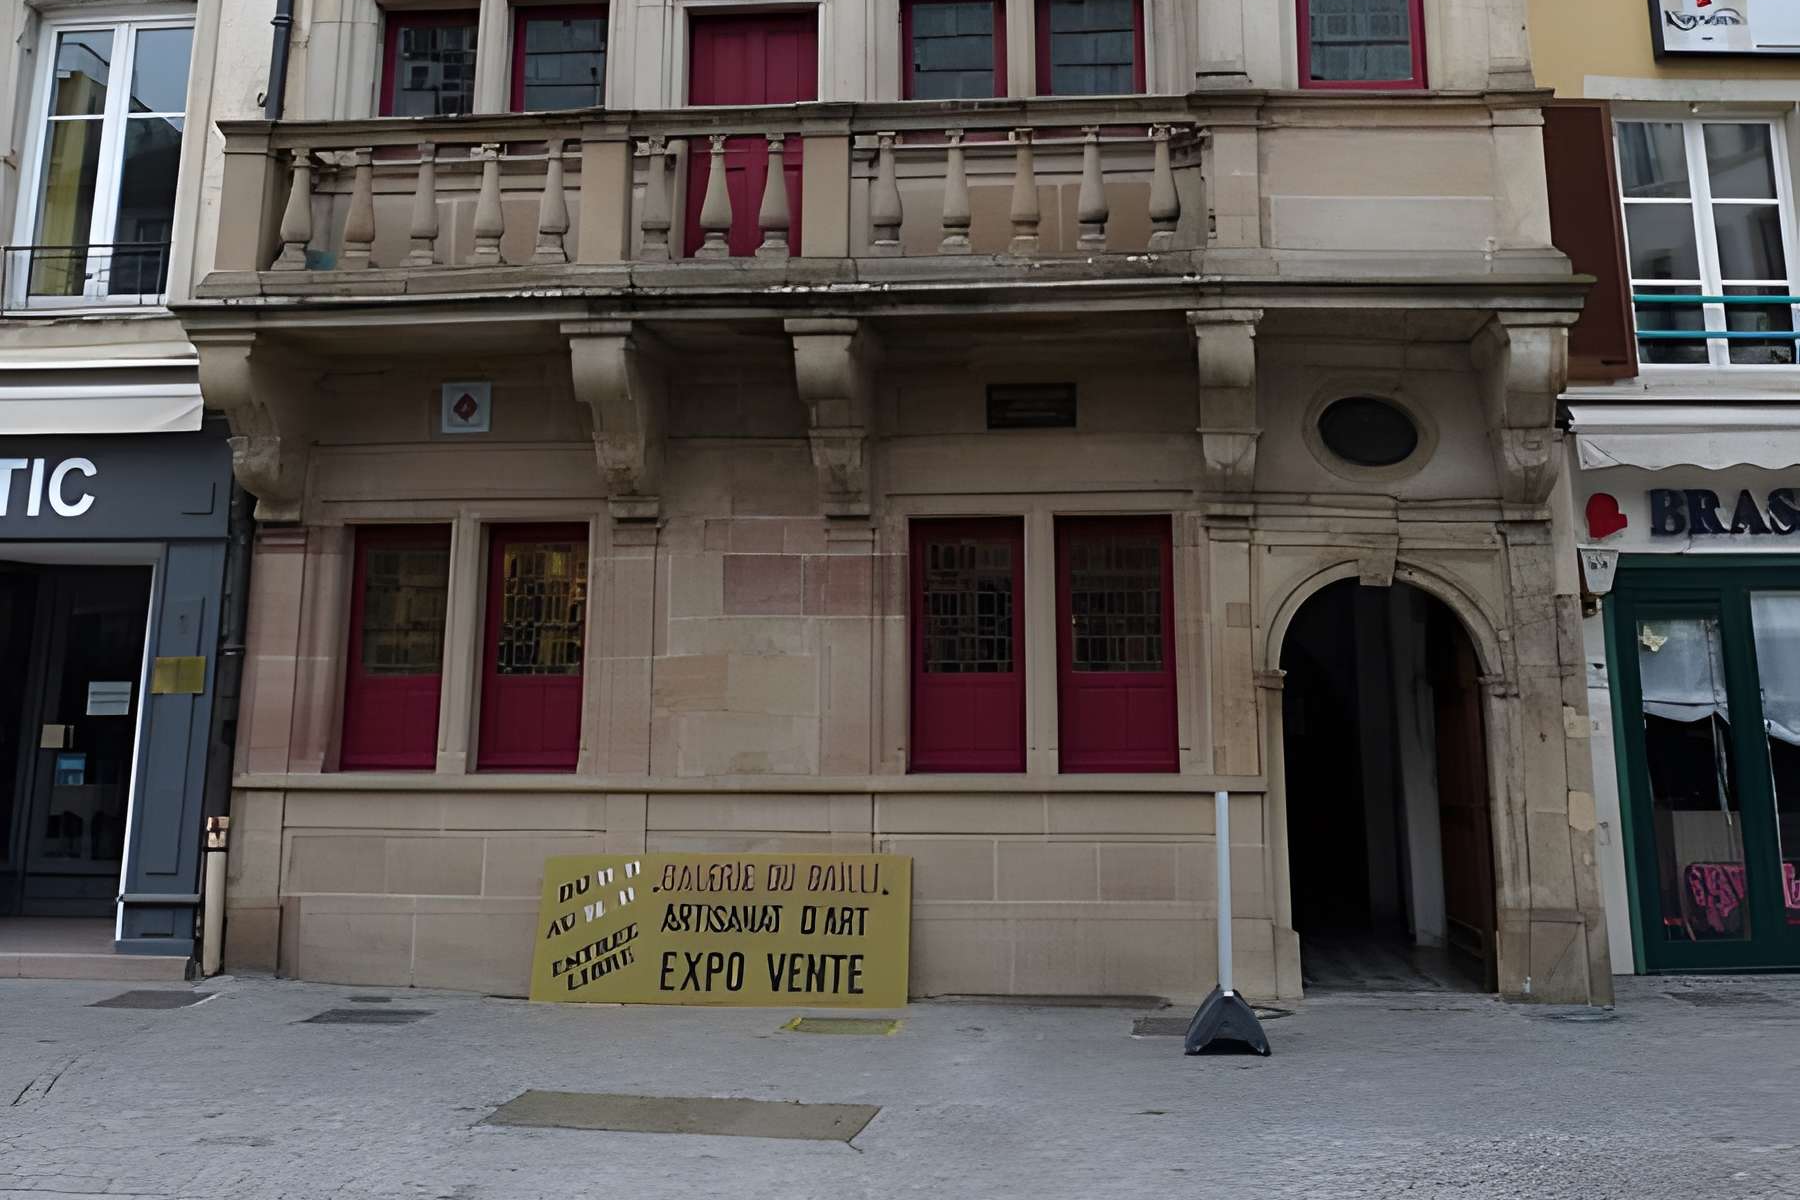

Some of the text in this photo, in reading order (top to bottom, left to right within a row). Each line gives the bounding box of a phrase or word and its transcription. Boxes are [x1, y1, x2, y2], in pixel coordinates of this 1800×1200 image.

[767, 863, 796, 892] DU
[659, 951, 864, 994] EXPO VENTE
